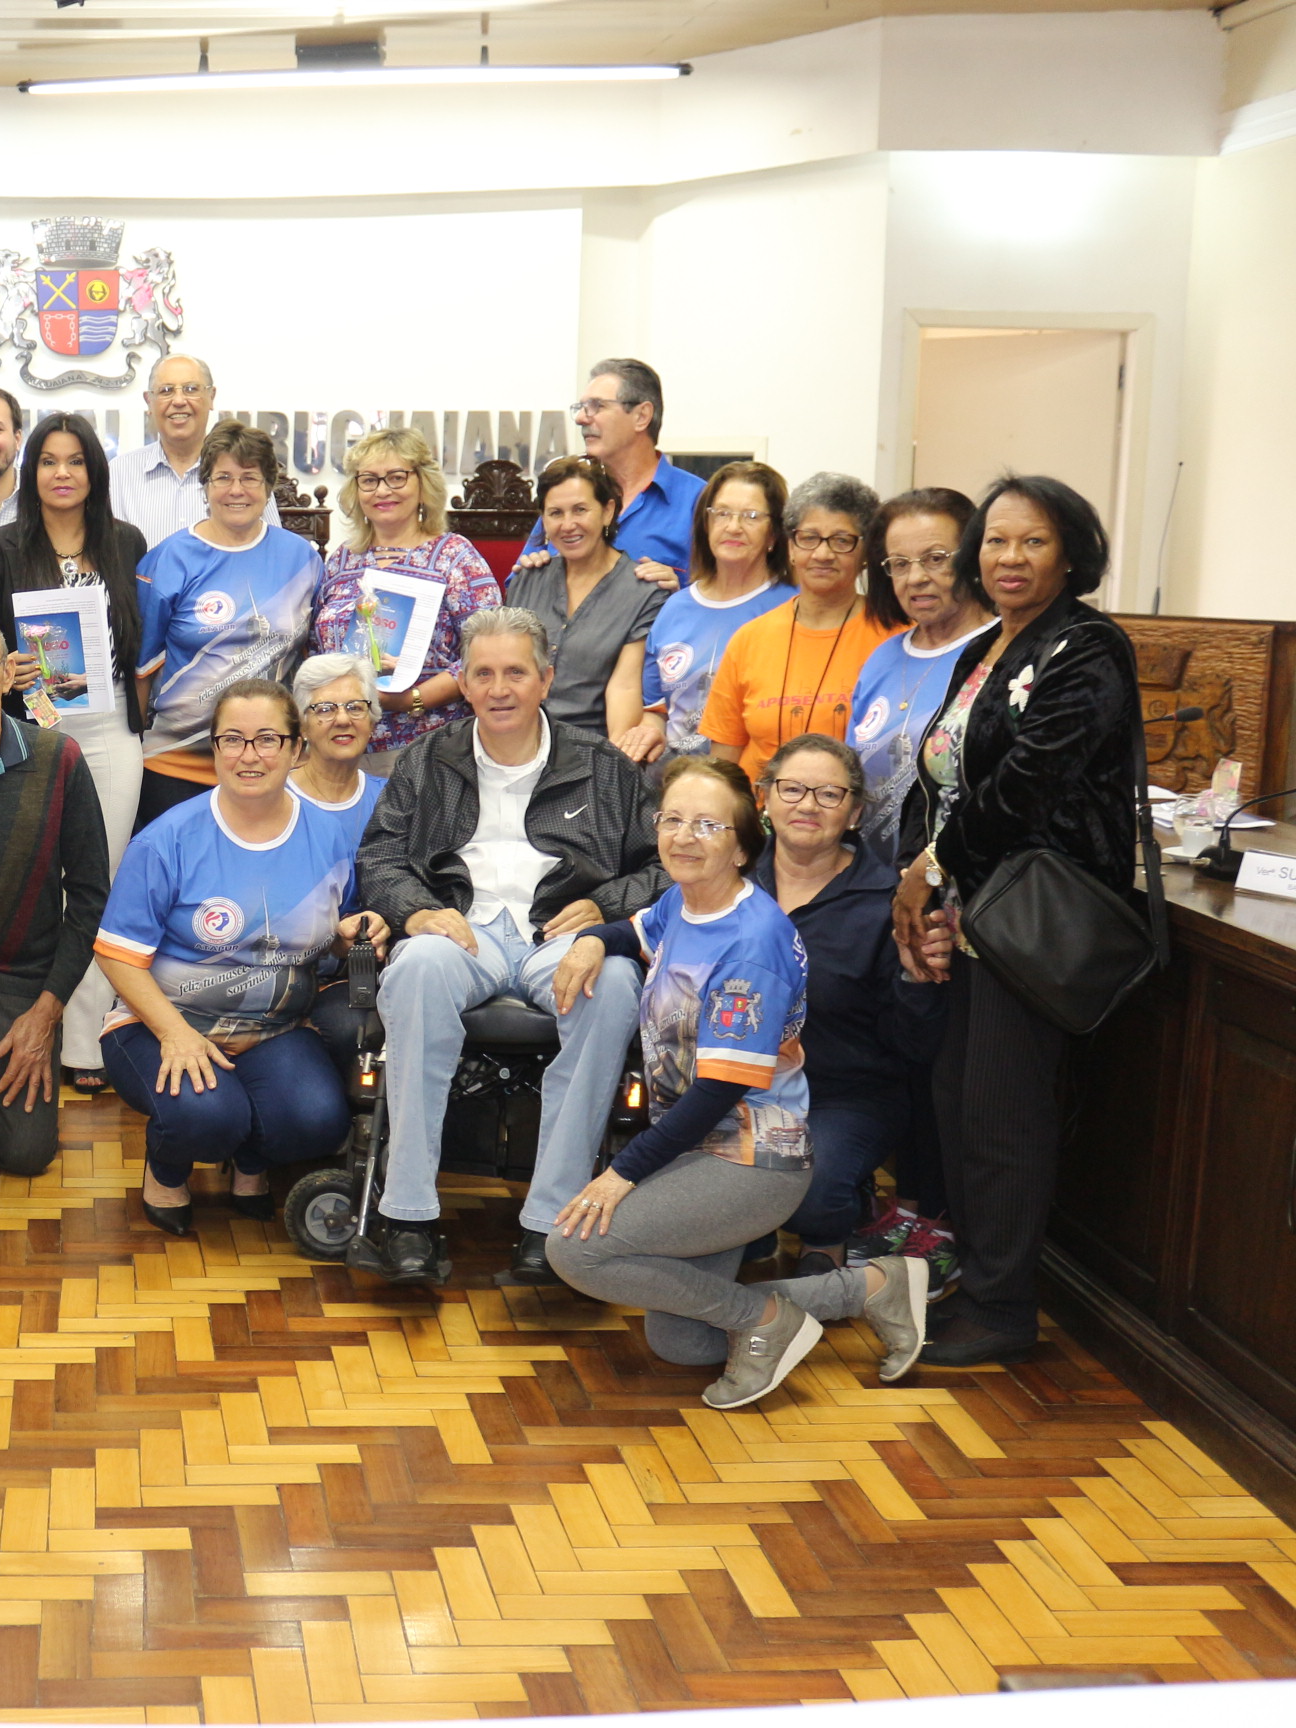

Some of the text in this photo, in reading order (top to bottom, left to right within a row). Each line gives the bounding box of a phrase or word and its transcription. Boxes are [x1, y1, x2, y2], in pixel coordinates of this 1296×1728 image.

[219, 410, 570, 476] RUGAIANA
[757, 693, 854, 708] APOSENTA
[195, 943, 239, 951] ATAPUR
[179, 980, 201, 996] feliz
[203, 976, 214, 987] tu
[217, 965, 252, 983] nasce
[227, 969, 270, 996] sorrindo
